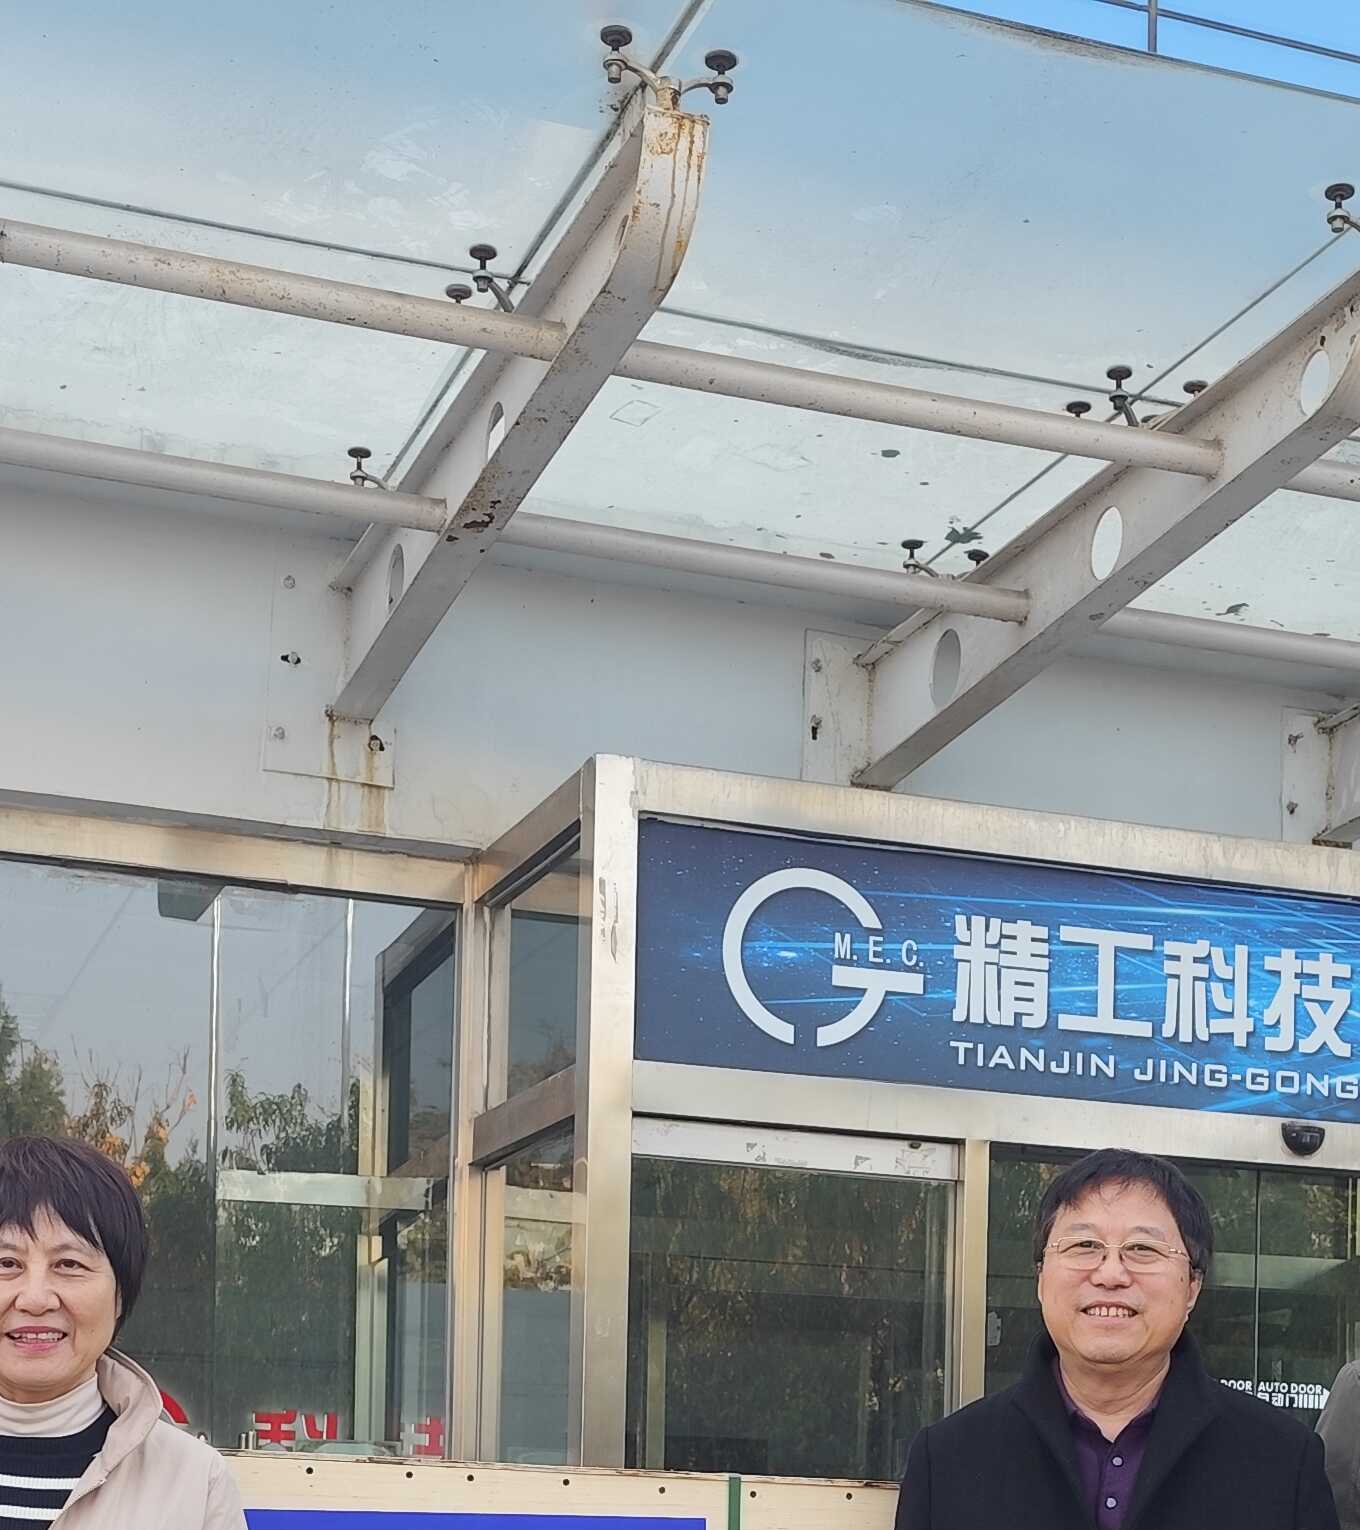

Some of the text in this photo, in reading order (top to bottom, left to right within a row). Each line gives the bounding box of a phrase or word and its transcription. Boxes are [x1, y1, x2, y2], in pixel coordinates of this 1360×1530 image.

[949, 1040, 1116, 1079] TIANJIN
[1133, 1062, 1360, 1100] JING-GONG
[1258, 1381, 1322, 1395] AUTO DOOR
